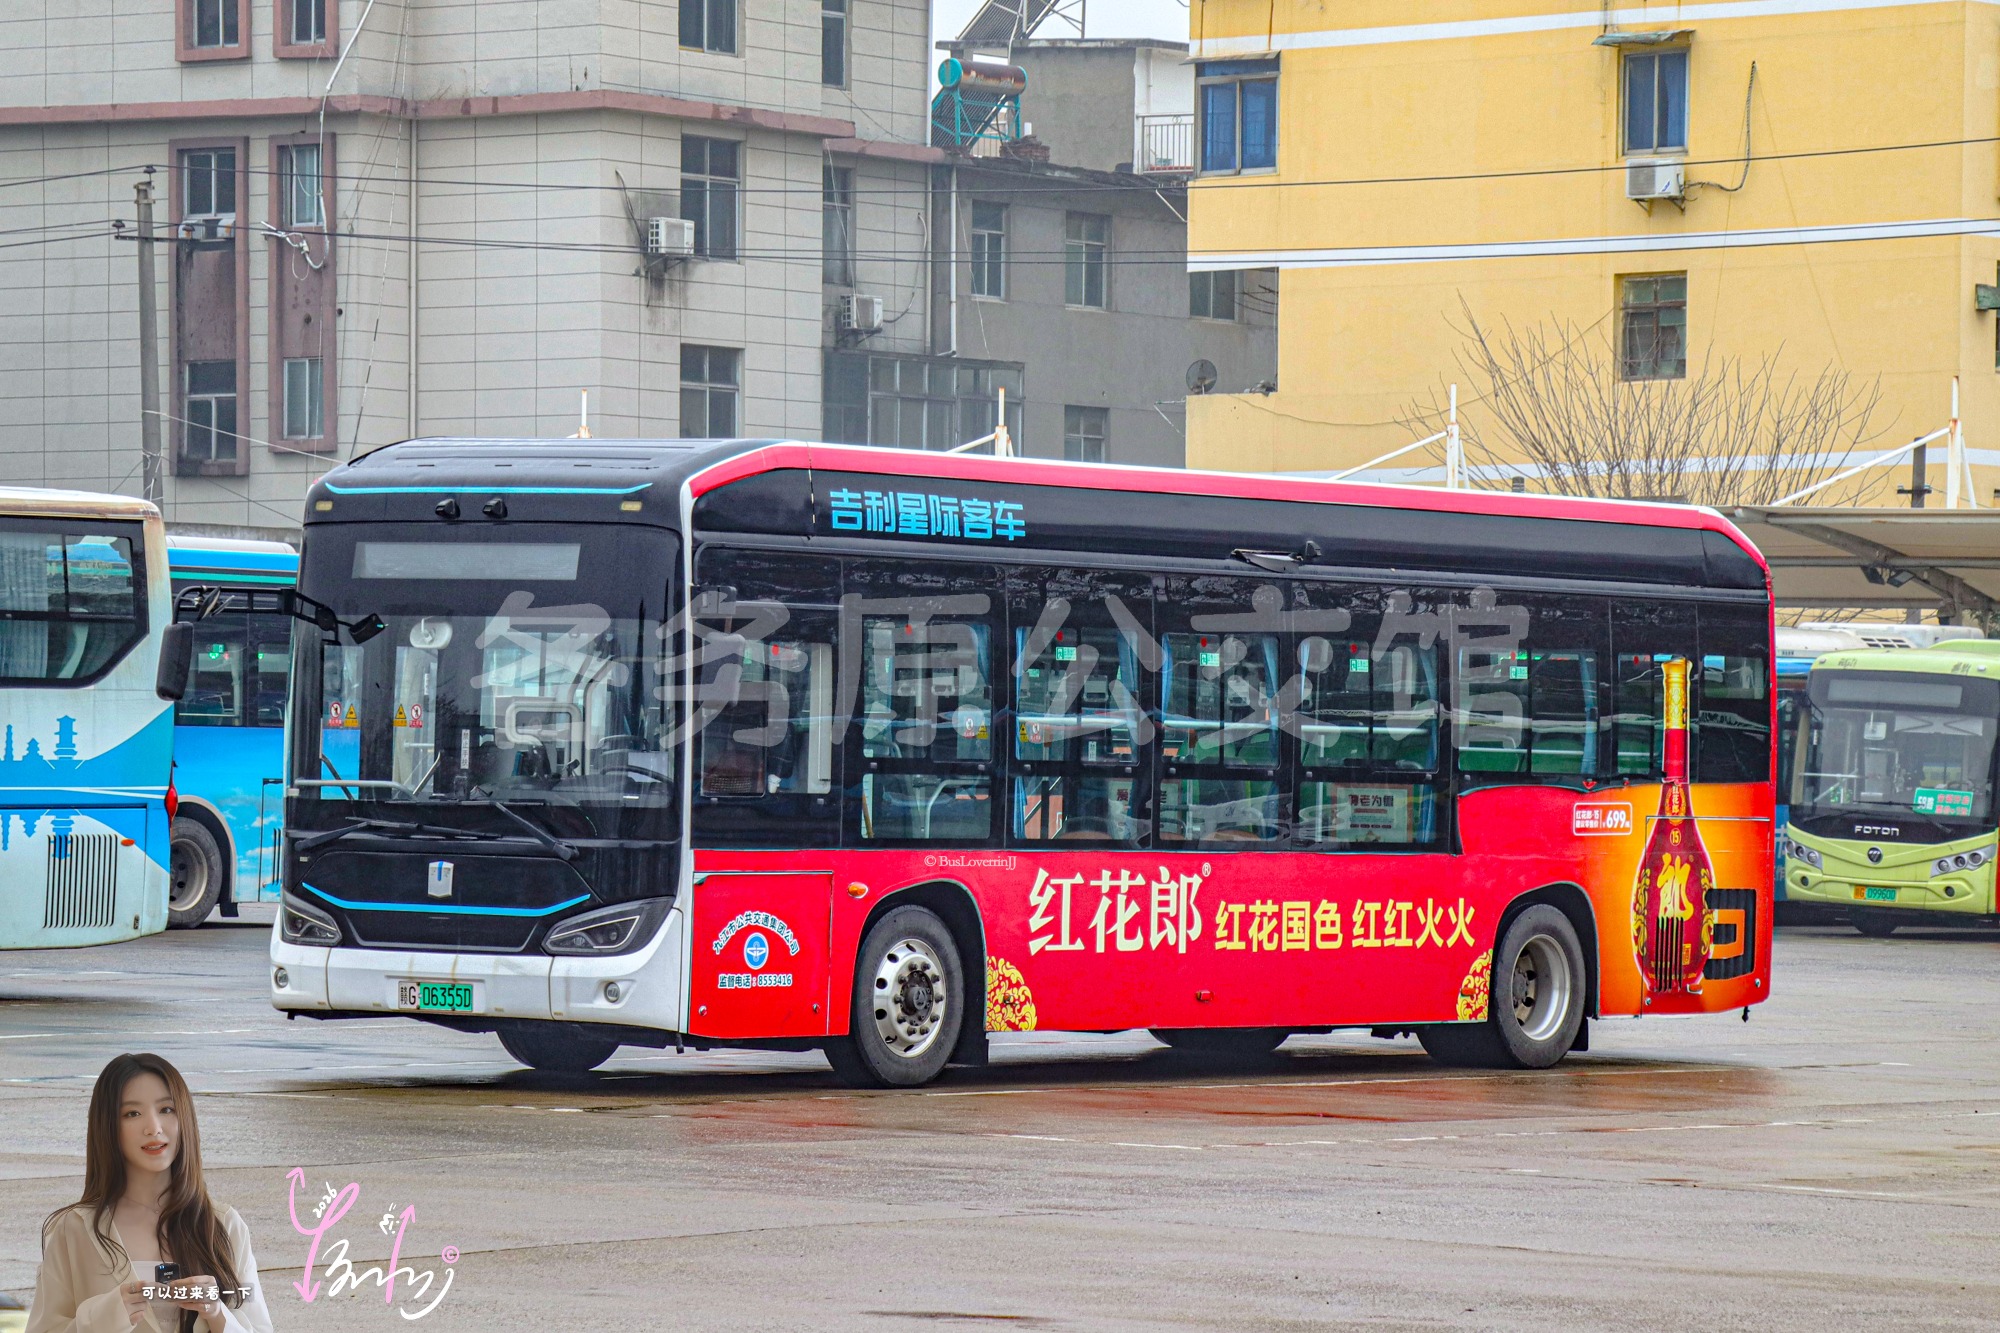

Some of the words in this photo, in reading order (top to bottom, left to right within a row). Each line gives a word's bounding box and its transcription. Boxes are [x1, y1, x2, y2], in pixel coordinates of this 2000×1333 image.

[829, 488, 1026, 541] 吉利星际客车
[1854, 825, 1900, 836] FOTON
[712, 911, 800, 956] 九江市公共交通集团公司
[1214, 898, 1344, 952] 红花国色
[1351, 897, 1476, 949] 红红火火
